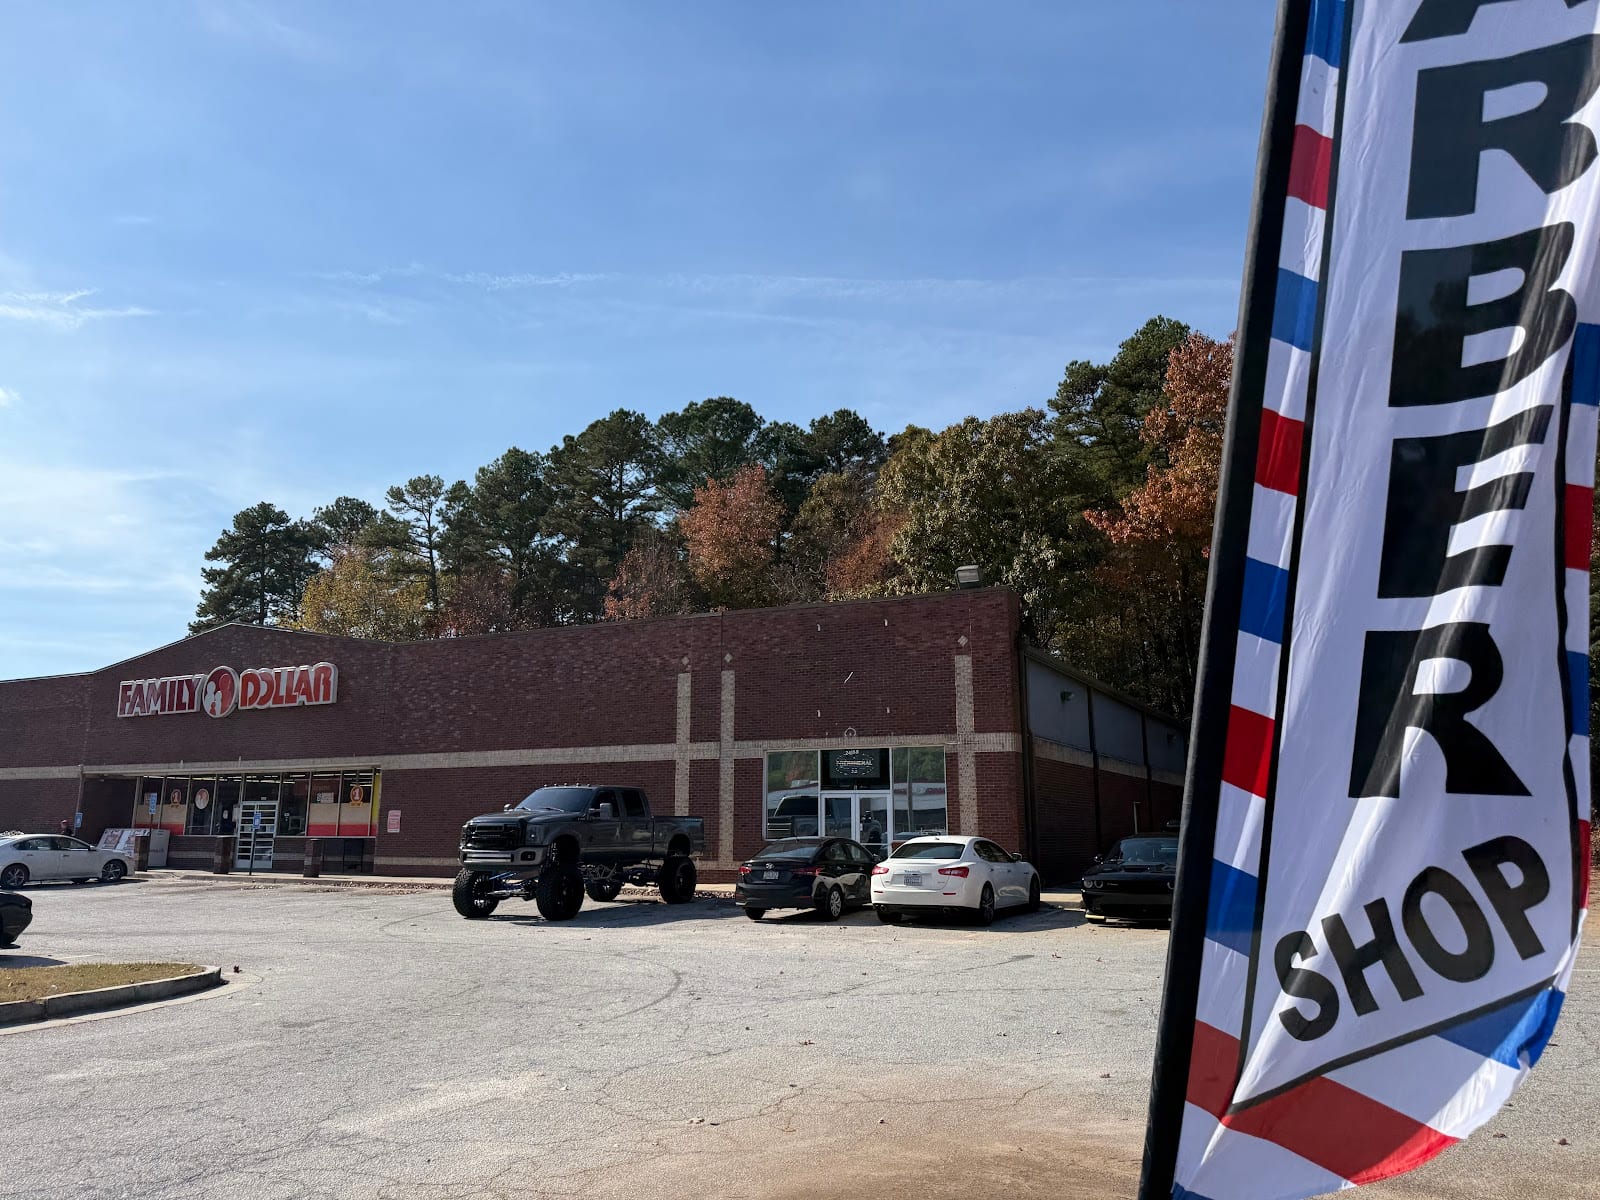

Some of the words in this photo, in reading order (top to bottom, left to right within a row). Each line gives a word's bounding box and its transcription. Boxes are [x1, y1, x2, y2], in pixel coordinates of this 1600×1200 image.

[1348, 0, 1600, 798] RBER
[118, 675, 204, 717] FAMILY
[239, 662, 337, 709] DOLLAR
[1273, 834, 1551, 1042] SHOP
